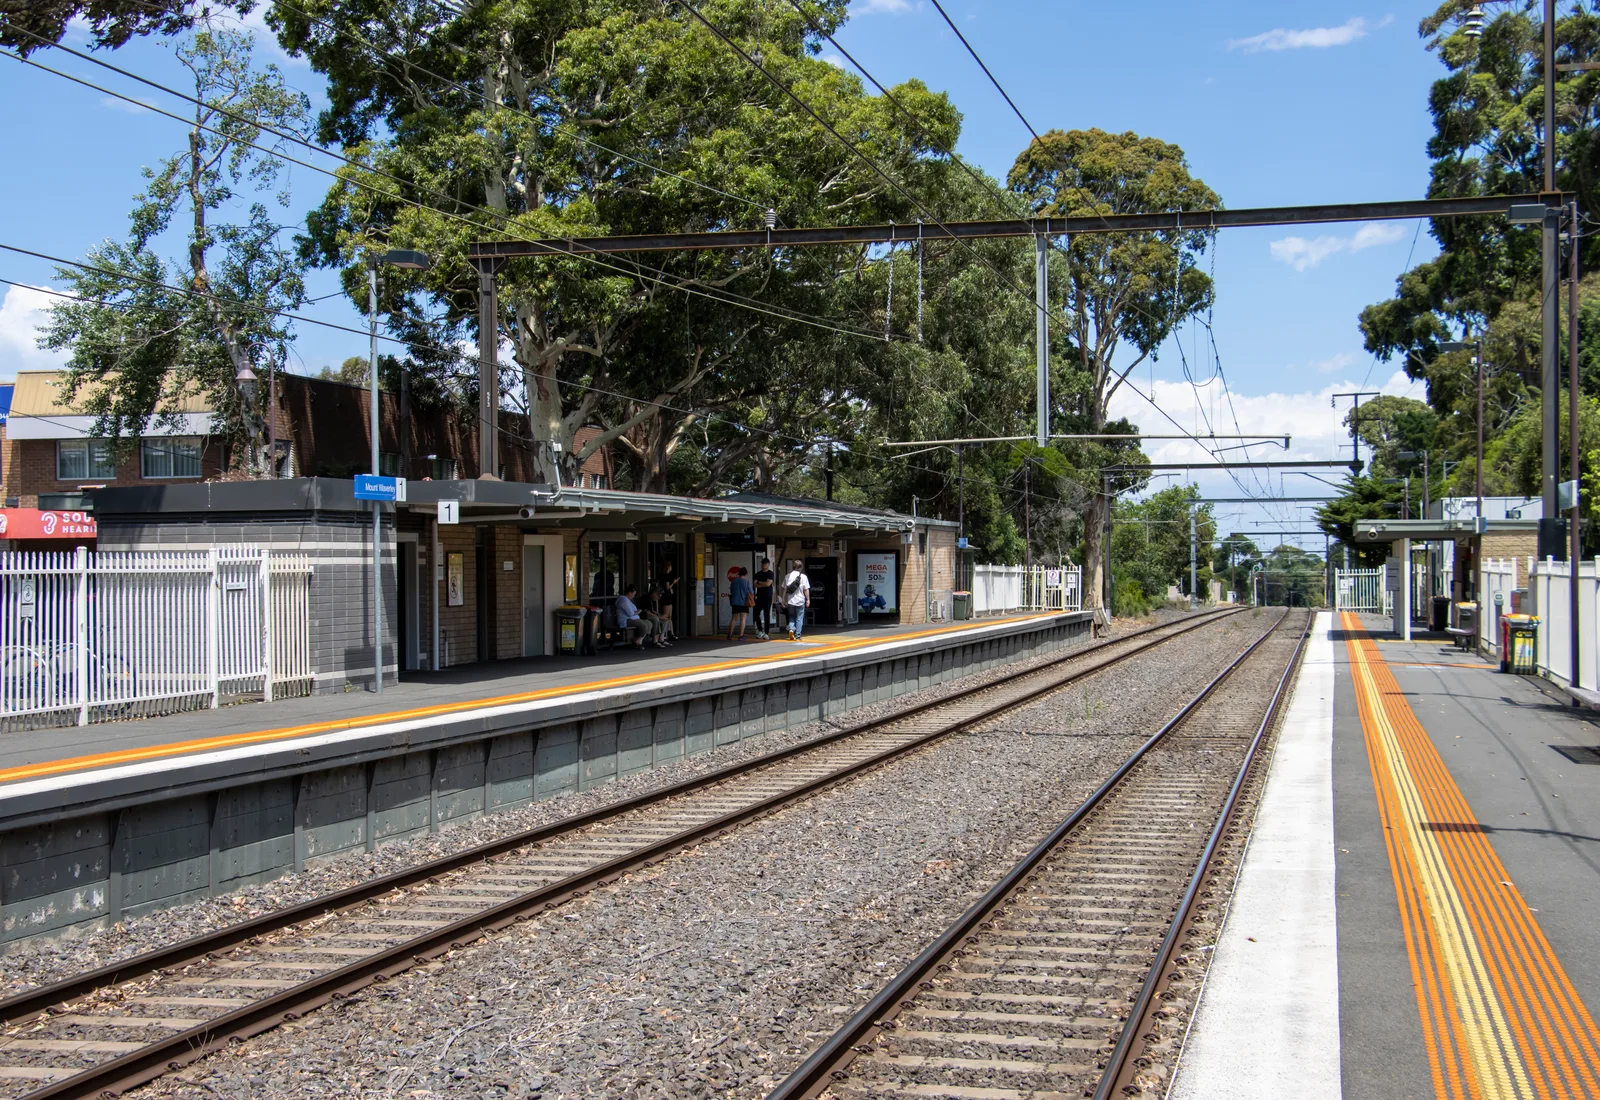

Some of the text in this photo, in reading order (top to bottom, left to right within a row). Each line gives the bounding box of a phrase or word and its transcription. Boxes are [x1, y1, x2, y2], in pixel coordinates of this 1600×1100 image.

[365, 481, 403, 499] Mount Waverley 1
[62, 512, 91, 523] SOU
[444, 504, 451, 522] 1
